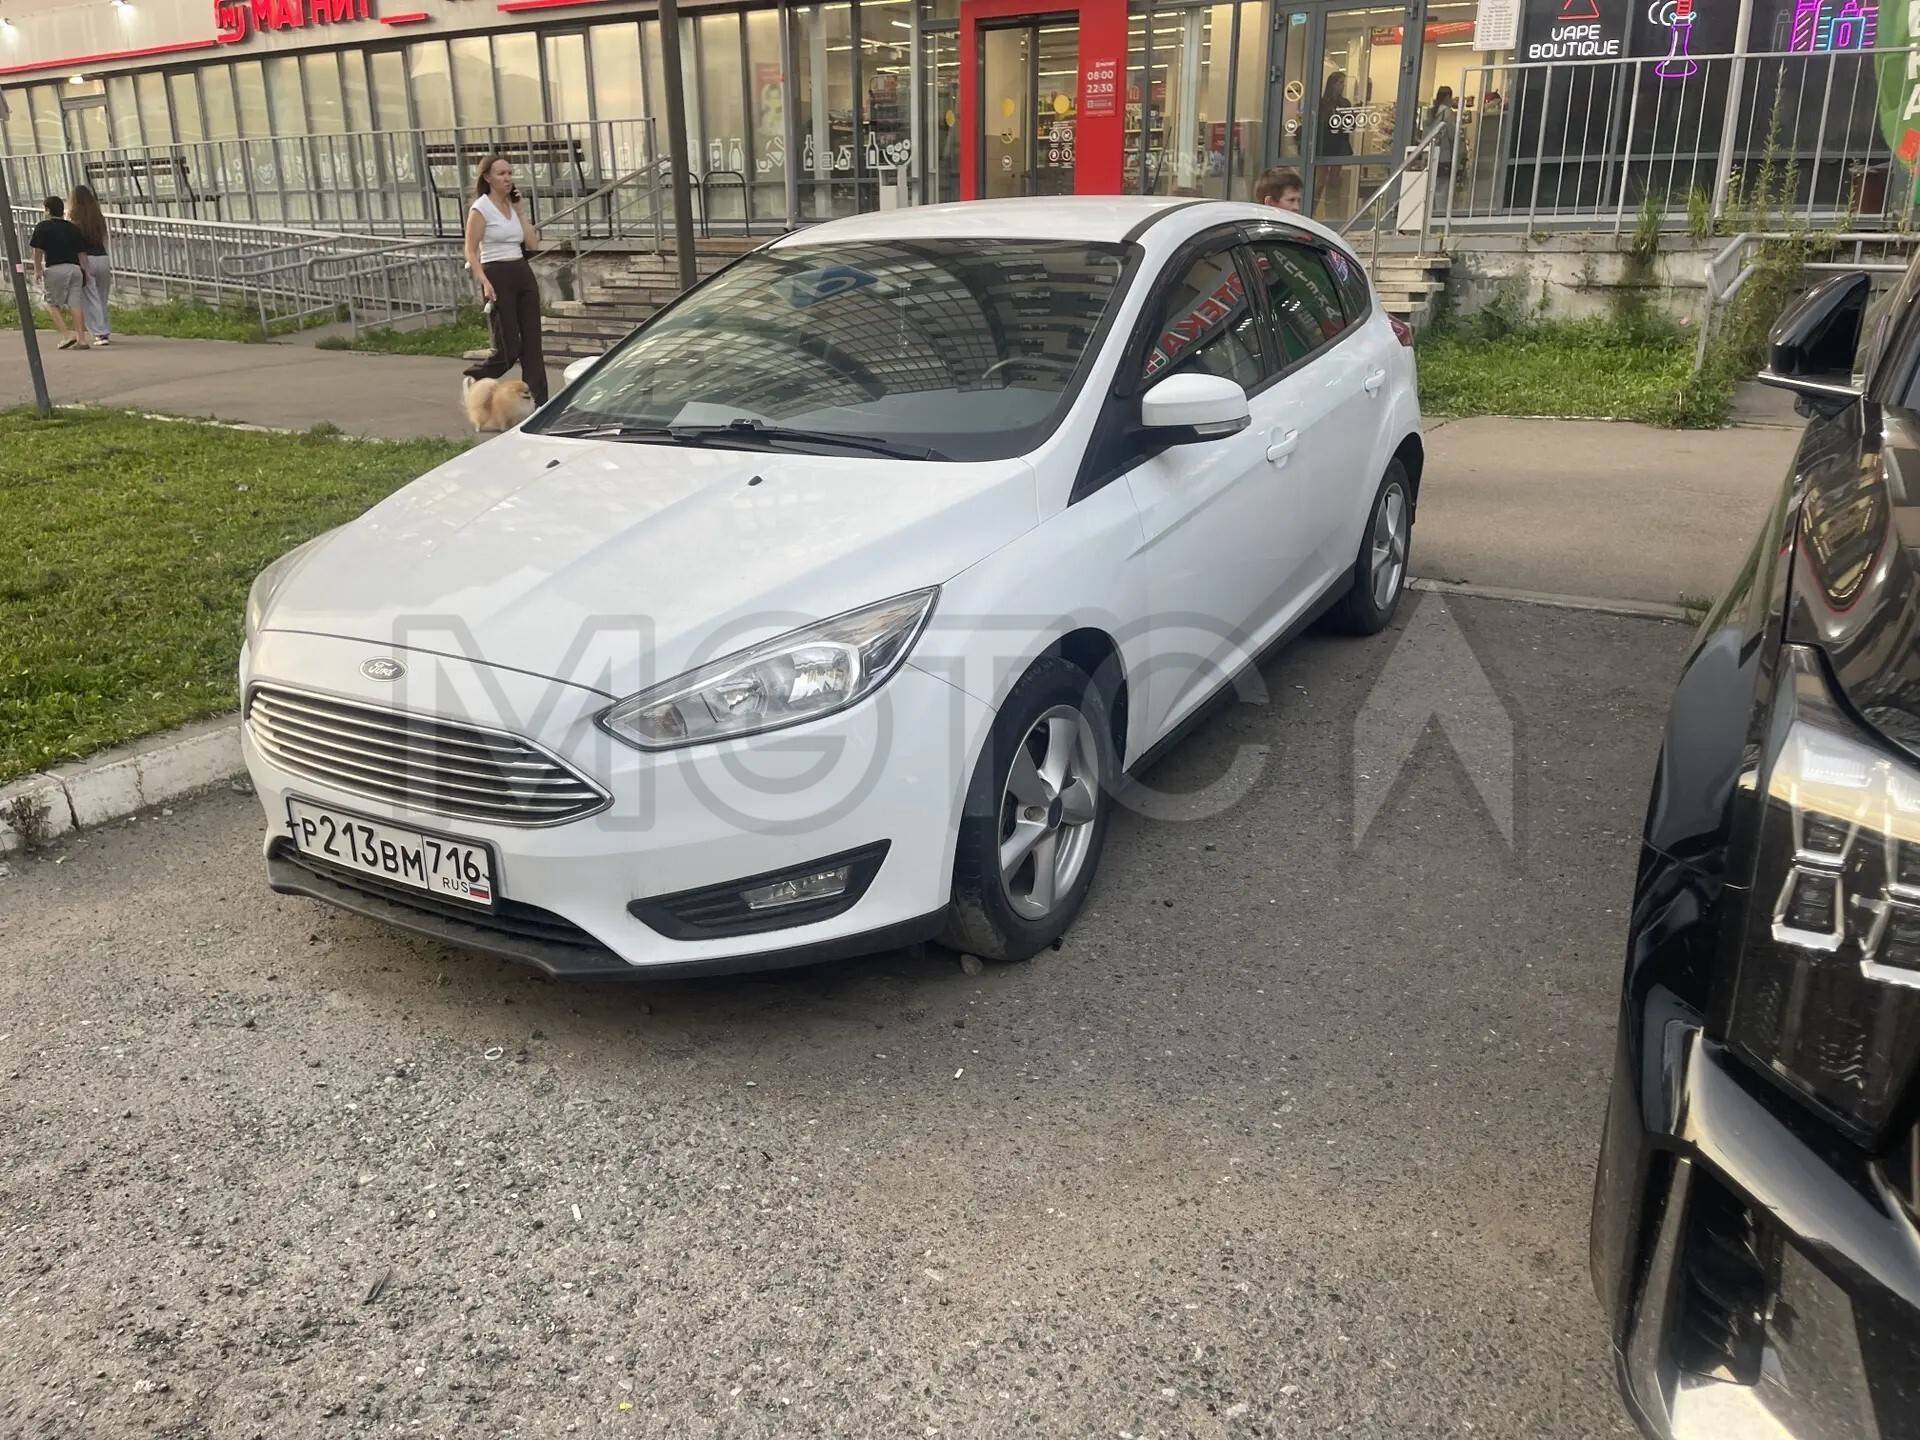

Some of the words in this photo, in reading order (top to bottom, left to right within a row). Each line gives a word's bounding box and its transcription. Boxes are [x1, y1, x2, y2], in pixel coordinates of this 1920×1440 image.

[1551, 25, 1601, 41] VAPE
[1528, 39, 1620, 59] BOUTIQUE
[442, 876, 469, 893] RUS
